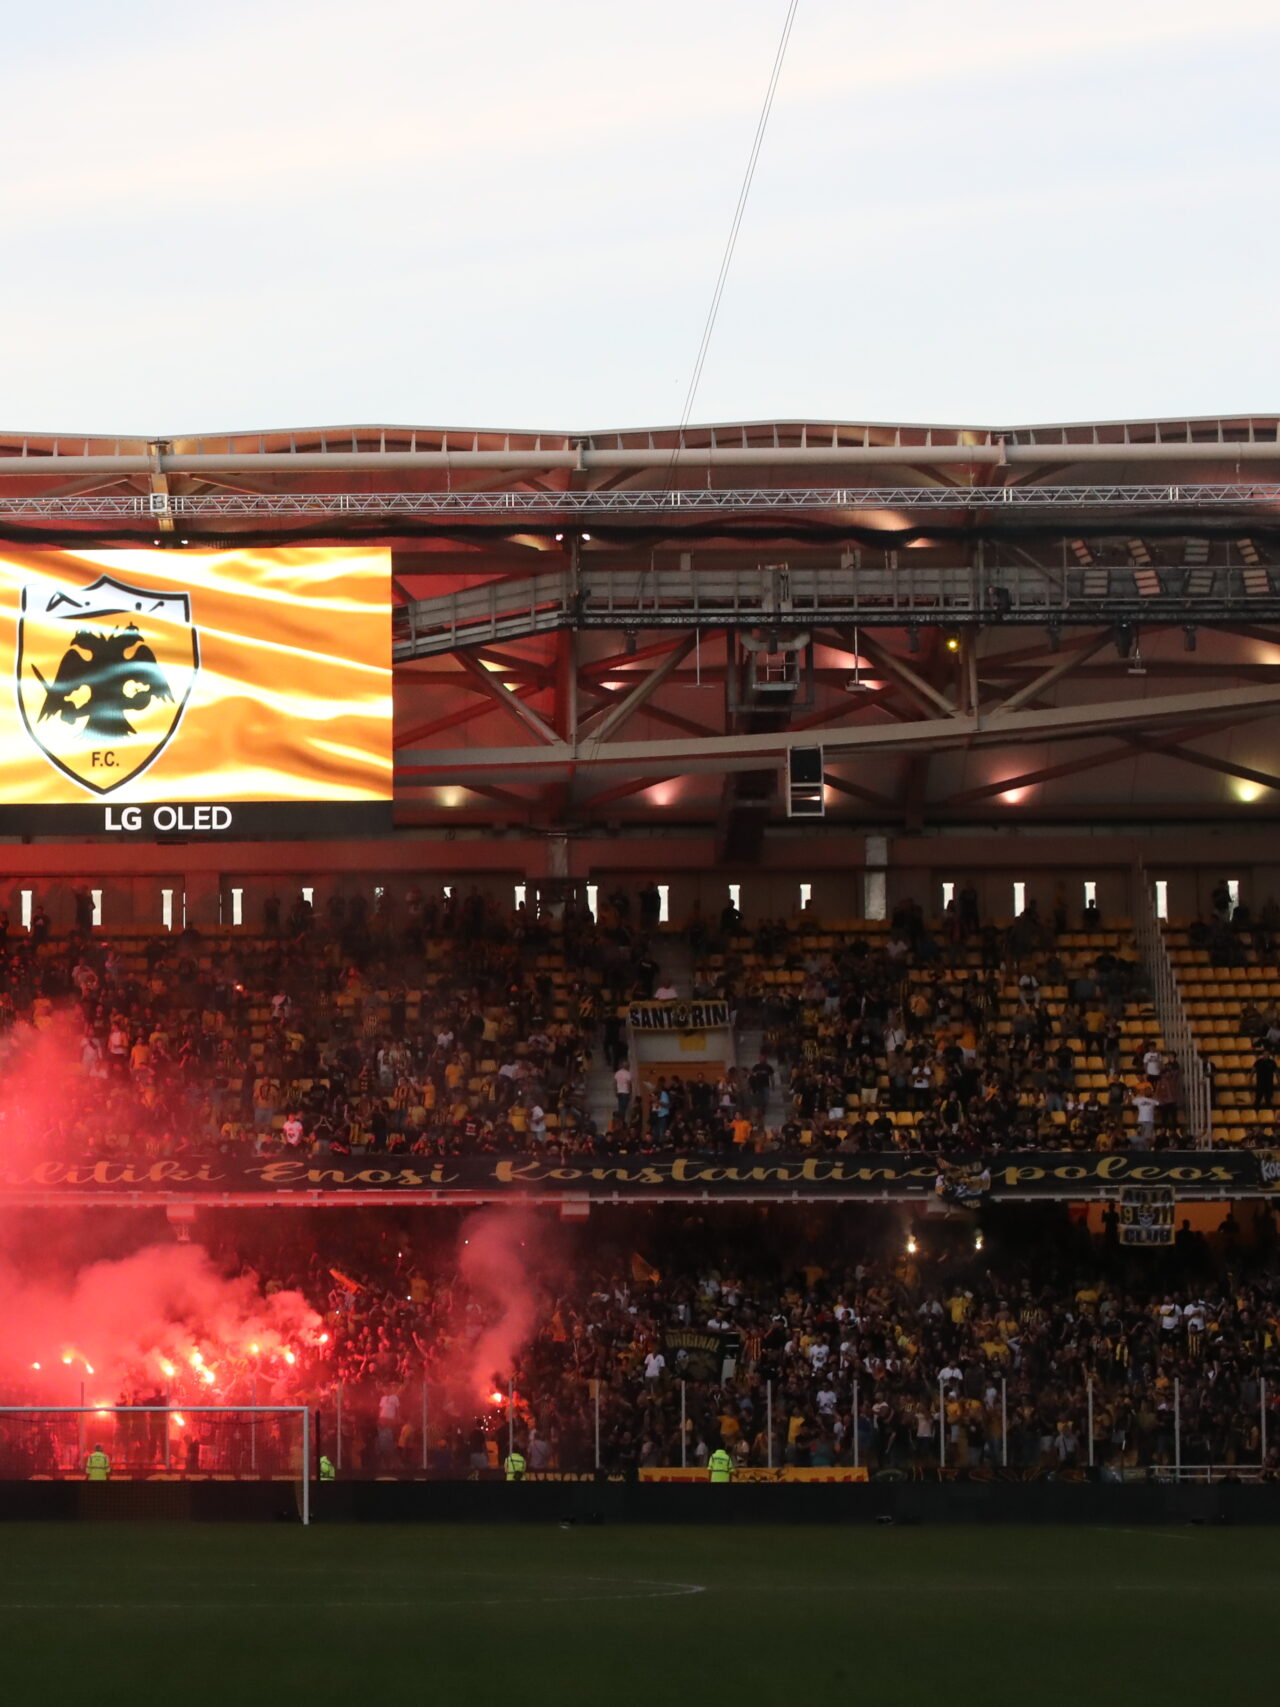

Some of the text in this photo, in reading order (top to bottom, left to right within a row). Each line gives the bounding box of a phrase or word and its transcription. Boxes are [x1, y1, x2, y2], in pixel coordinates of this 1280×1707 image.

[91, 751, 119, 768] F.C.
[105, 806, 233, 831] LG OLED
[244, 1161, 460, 1185] Enosi
